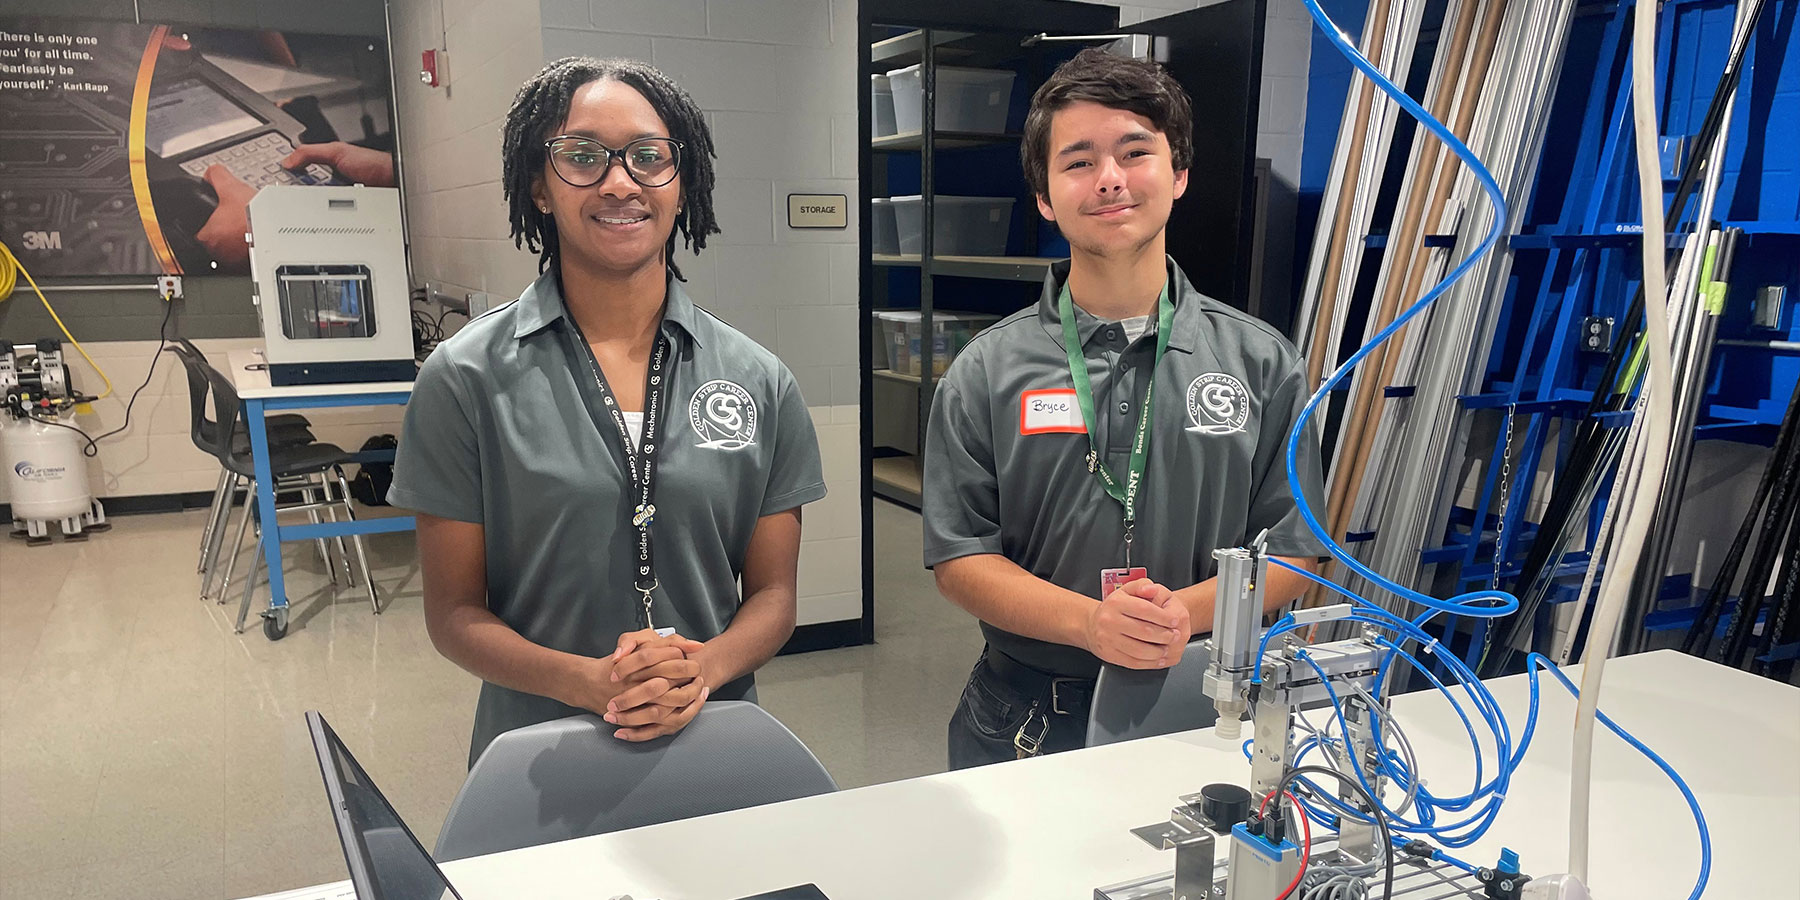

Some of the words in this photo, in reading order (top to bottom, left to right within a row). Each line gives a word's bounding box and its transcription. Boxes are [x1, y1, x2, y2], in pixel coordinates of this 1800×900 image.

[48, 34, 72, 46] only
[76, 36, 98, 45] one
[24, 47, 41, 58] for
[45, 49, 60, 59] all
[62, 50, 94, 60] time.
[59, 64, 74, 75] be
[63, 82, 83, 91] Karl
[84, 82, 109, 93] Rapp
[800, 206, 836, 214] STORAGE
[22, 231, 62, 250] 3M
[652, 346, 665, 371] Golden
[698, 383, 718, 400] STRIP
[720, 383, 749, 405] CAREER
[1190, 386, 1199, 416] GOLDEN
[1216, 376, 1243, 397] CAREER
[1235, 396, 1248, 425] CENTER
[646, 390, 658, 439] Mechatronics
[692, 398, 705, 431] GOLDEN
[1031, 399, 1069, 414] Bryce
[1140, 405, 1149, 431] Career
[612, 409, 626, 437] Golden
[745, 405, 755, 437] CENTER
[1136, 430, 1145, 455] Bonds
[642, 460, 651, 485] Center
[640, 533, 648, 561] Golden
